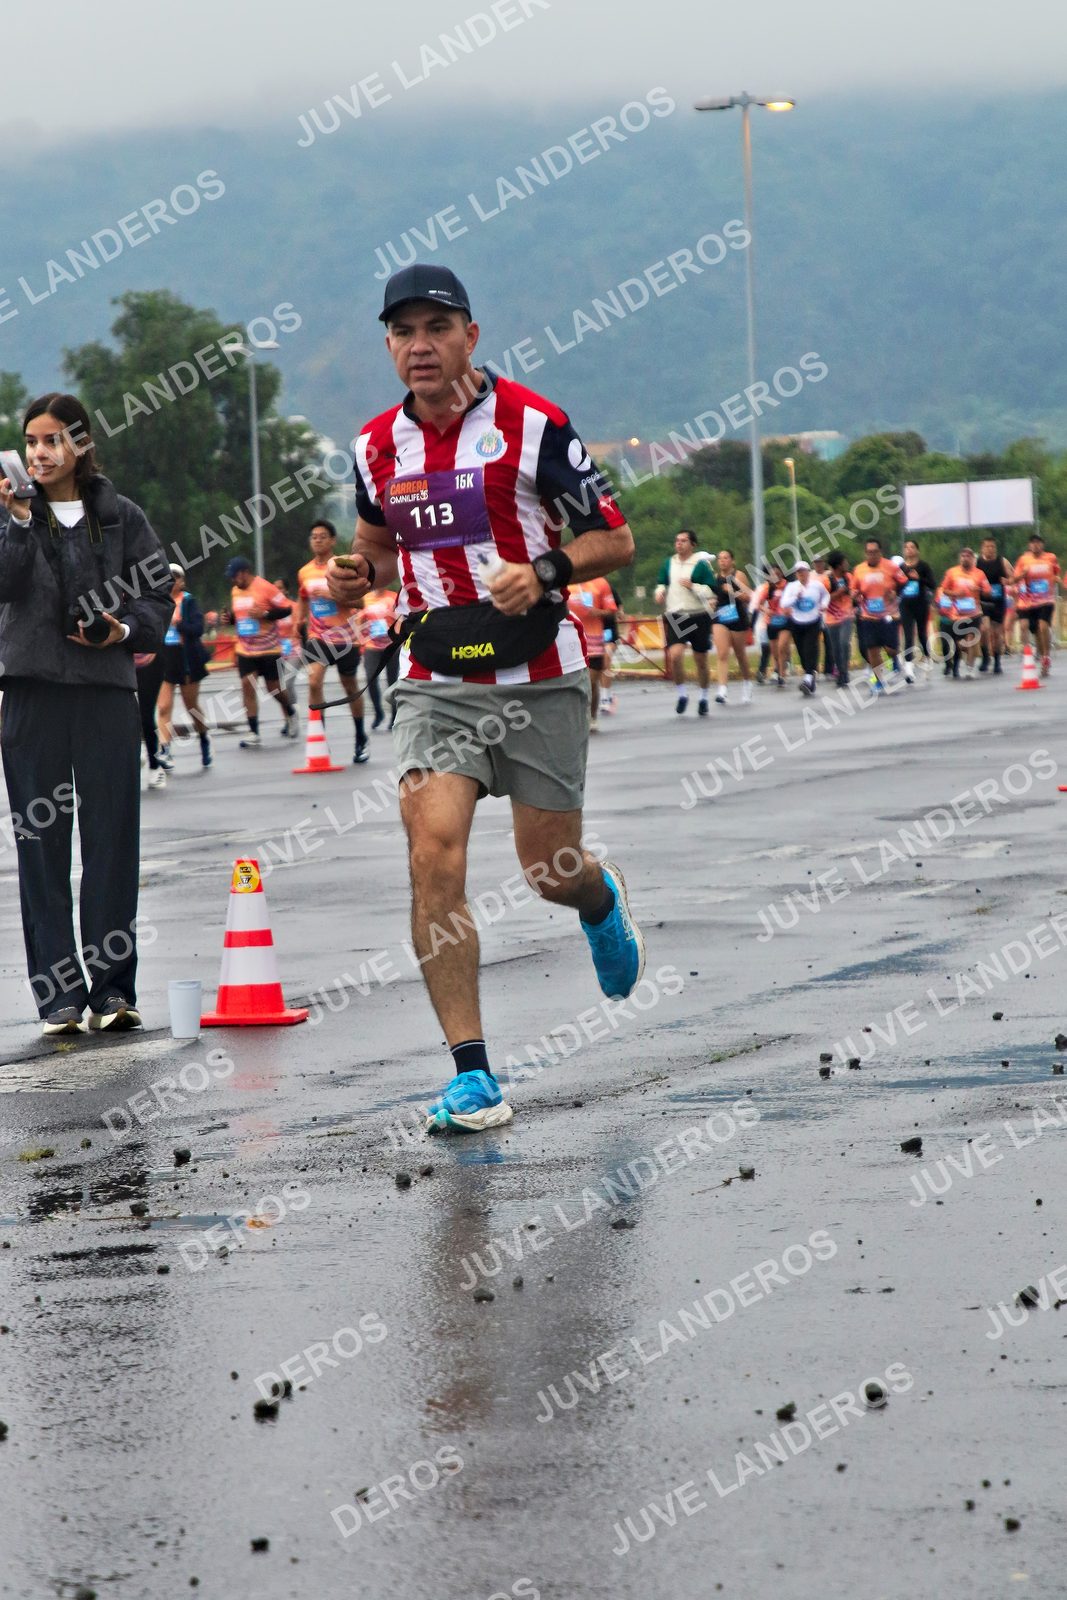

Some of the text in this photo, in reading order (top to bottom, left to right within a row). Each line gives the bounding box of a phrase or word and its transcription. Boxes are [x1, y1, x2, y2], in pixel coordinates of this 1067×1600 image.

[390, 480, 428, 496] CARRERA
[410, 502, 454, 528] 113
[451, 642, 495, 660] HOKA
